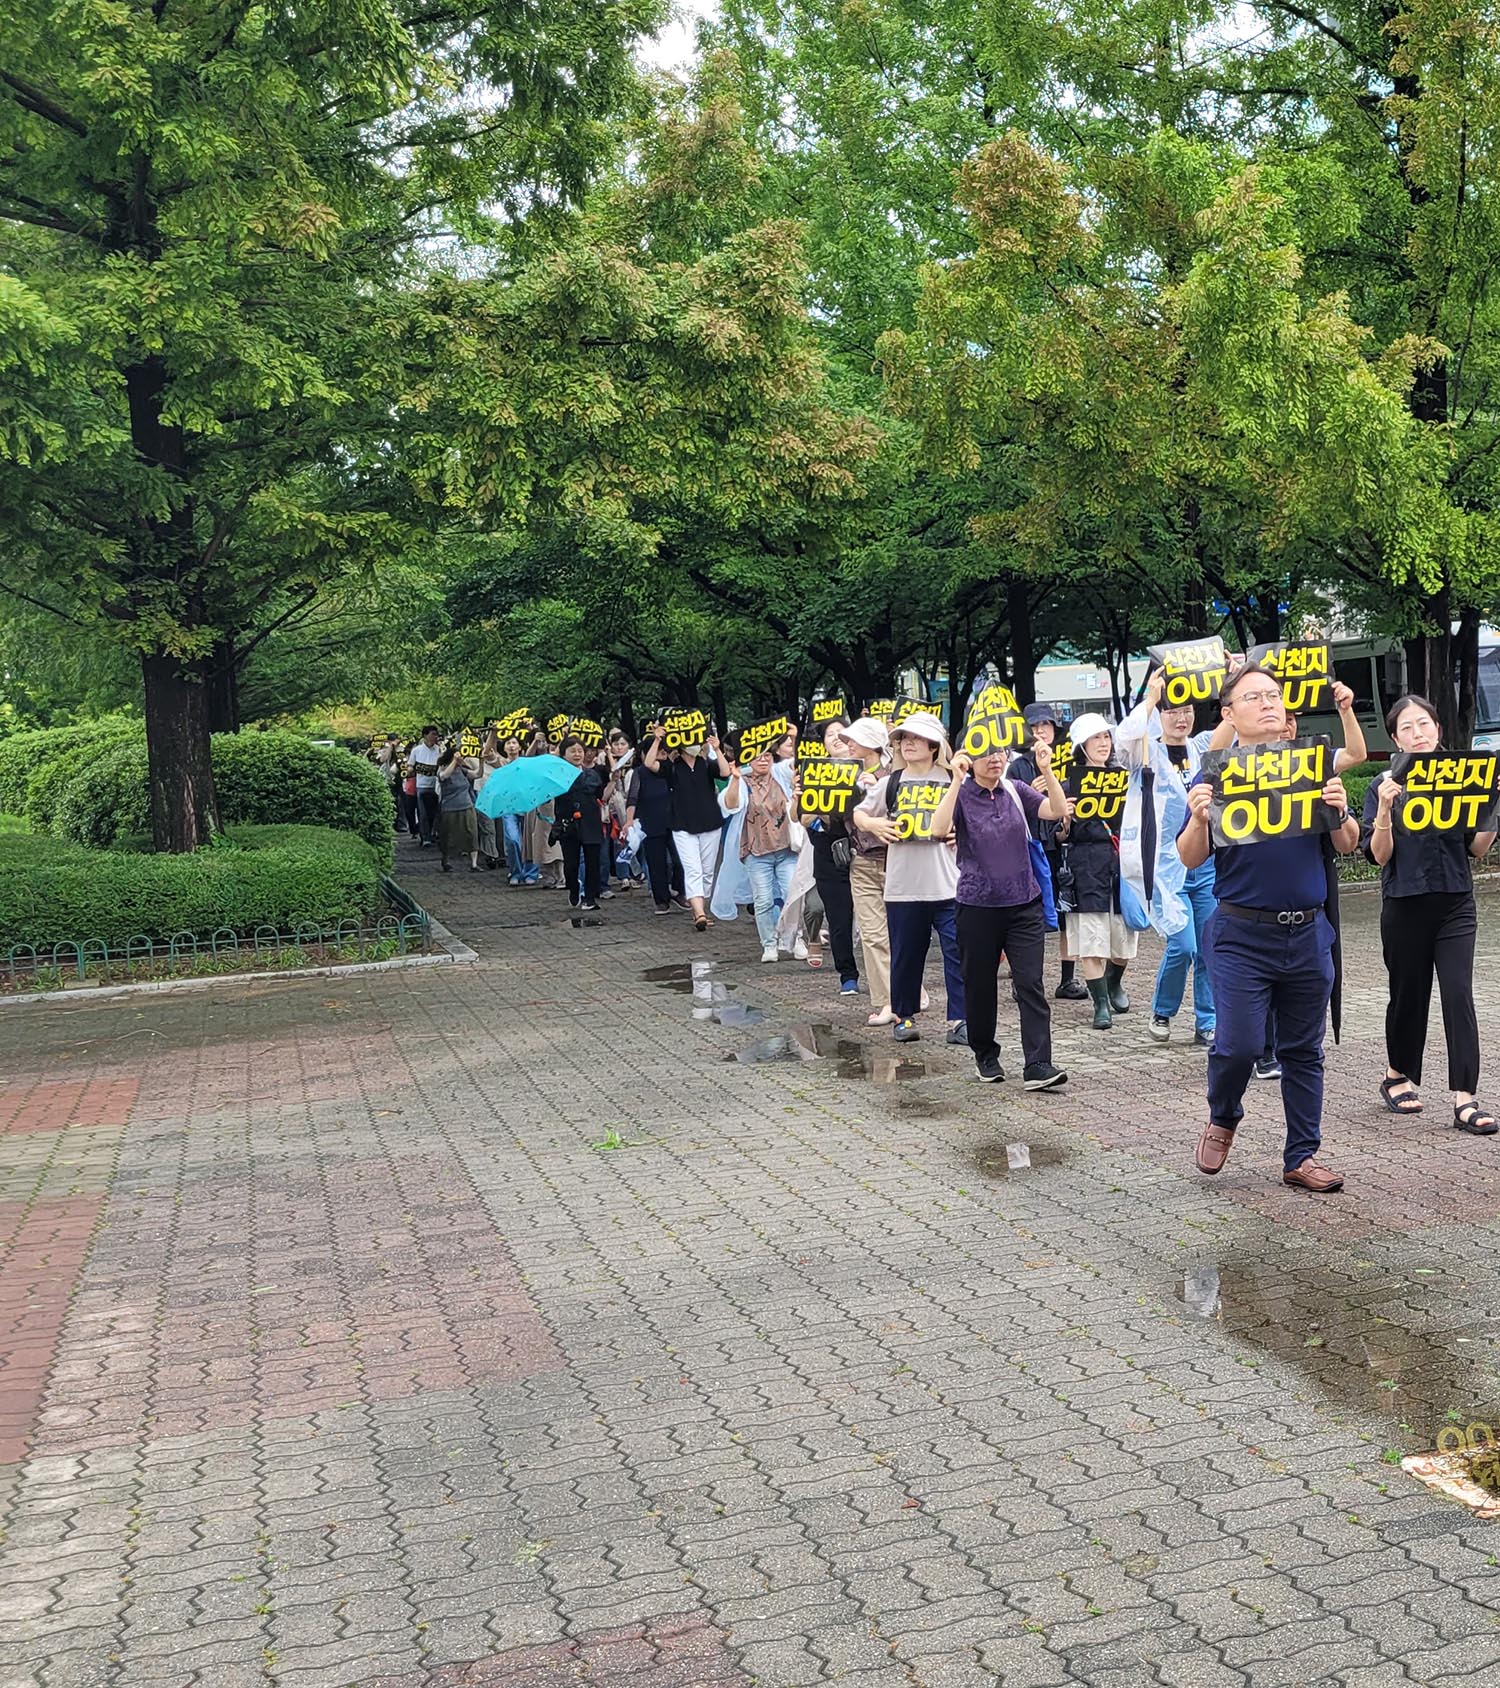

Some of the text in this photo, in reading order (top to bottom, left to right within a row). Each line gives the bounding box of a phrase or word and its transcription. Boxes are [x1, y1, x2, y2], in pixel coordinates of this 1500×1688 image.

[1163, 642, 1226, 675] 신천지
[1259, 645, 1328, 678] 신천지
[1167, 668, 1227, 705] OUT
[1283, 678, 1328, 710] UT
[665, 710, 706, 732] 신천지
[813, 699, 843, 721] 신천지
[666, 726, 707, 748] OUT
[740, 716, 787, 747] 신천지
[964, 717, 1025, 757] OUT
[803, 762, 859, 787] 신천지
[1220, 744, 1325, 796] 신천지
[1406, 757, 1497, 792] 신천지
[801, 788, 853, 813] OUT
[897, 785, 950, 811] 신천
[1075, 795, 1127, 819] OU
[1221, 789, 1324, 839] OUT
[1402, 794, 1490, 831] OUT
